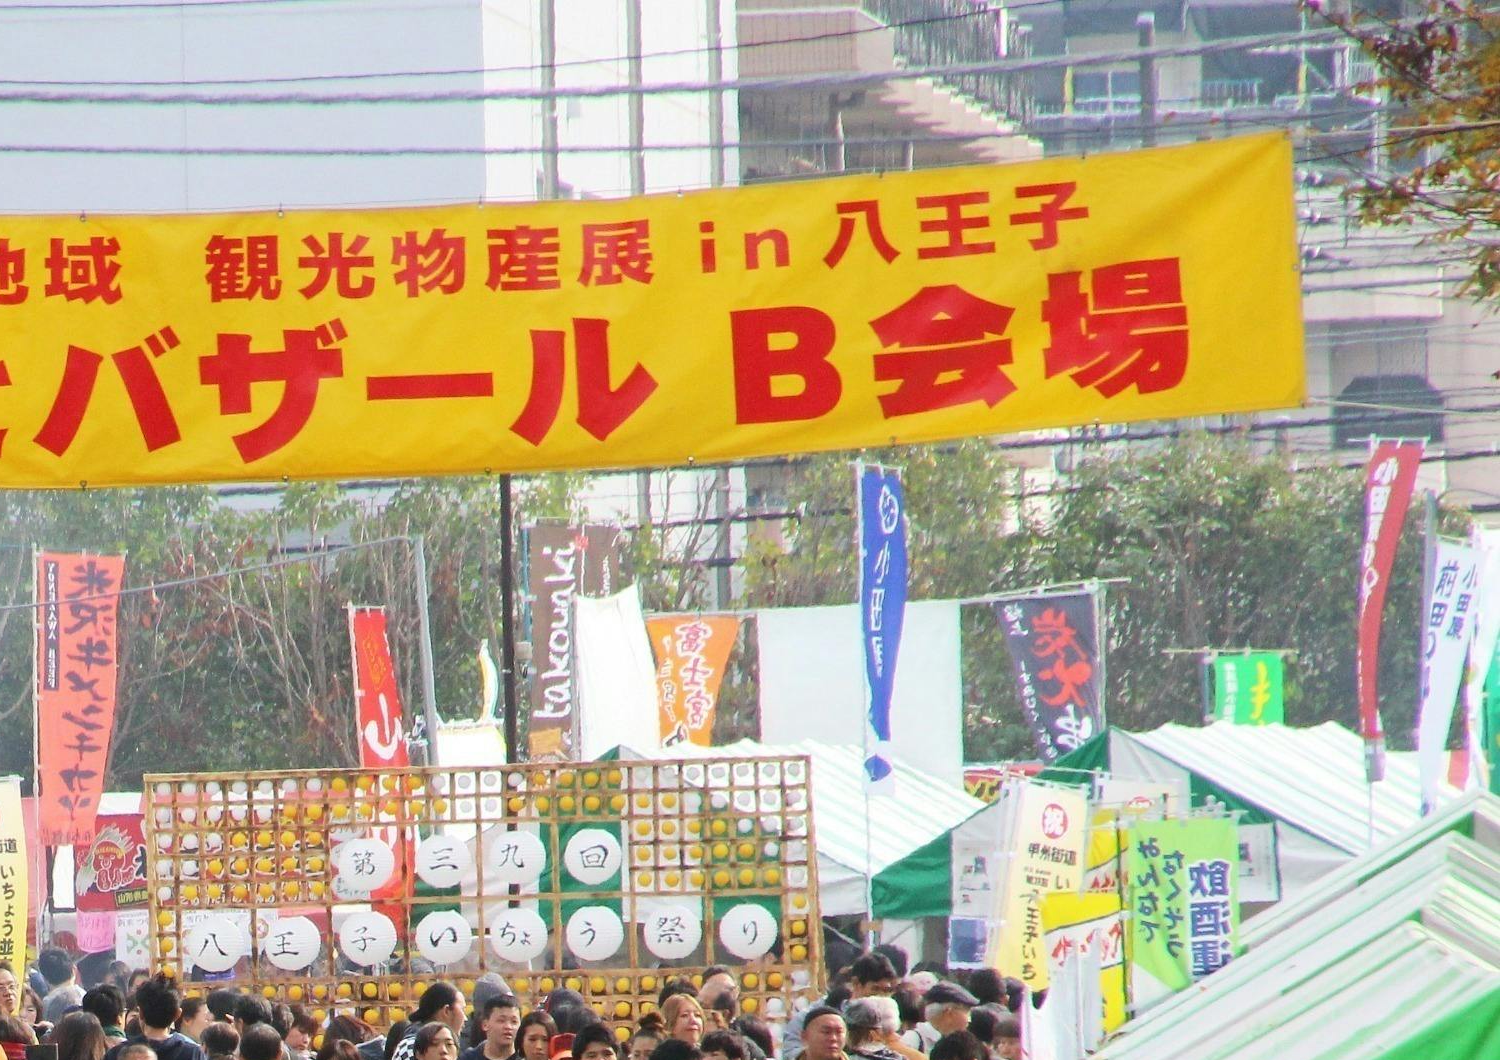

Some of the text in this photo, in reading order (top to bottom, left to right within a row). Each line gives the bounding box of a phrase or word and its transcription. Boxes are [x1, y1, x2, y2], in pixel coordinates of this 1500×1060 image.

[205, 217, 655, 303] 観光物産展
[698, 220, 790, 273] in
[823, 181, 1089, 269] 八王子
[729, 256, 1188, 425] B会場
